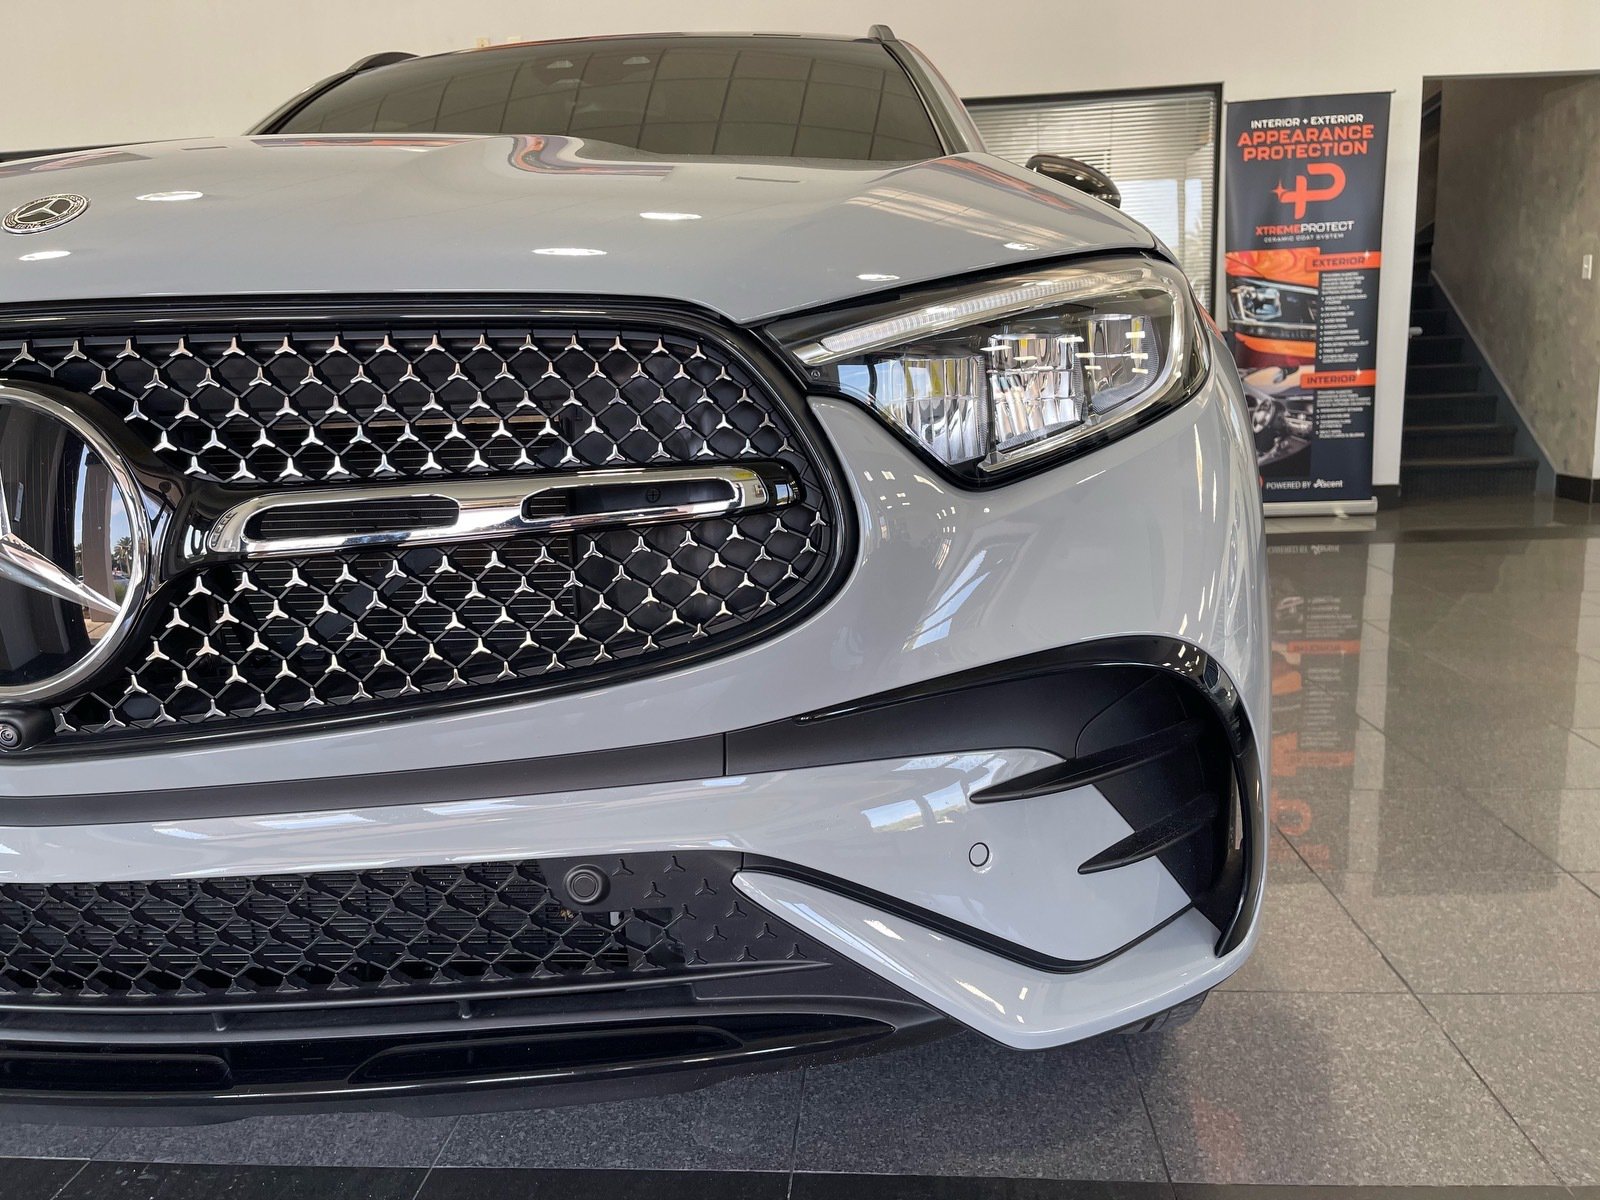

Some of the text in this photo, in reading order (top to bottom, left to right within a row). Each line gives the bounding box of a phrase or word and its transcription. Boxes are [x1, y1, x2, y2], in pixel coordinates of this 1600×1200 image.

[1251, 117, 1300, 129] INTERIOR
[1310, 113, 1364, 126] EXTERIOR
[1238, 125, 1374, 147] APPEARANCE
[1243, 141, 1369, 162] PROTECTION
[1312, 256, 1365, 268] EXTERIOR
[1307, 375, 1356, 384] INTERIOR
[1266, 481, 1301, 490] POWERED
[1302, 480, 1312, 489] BY
